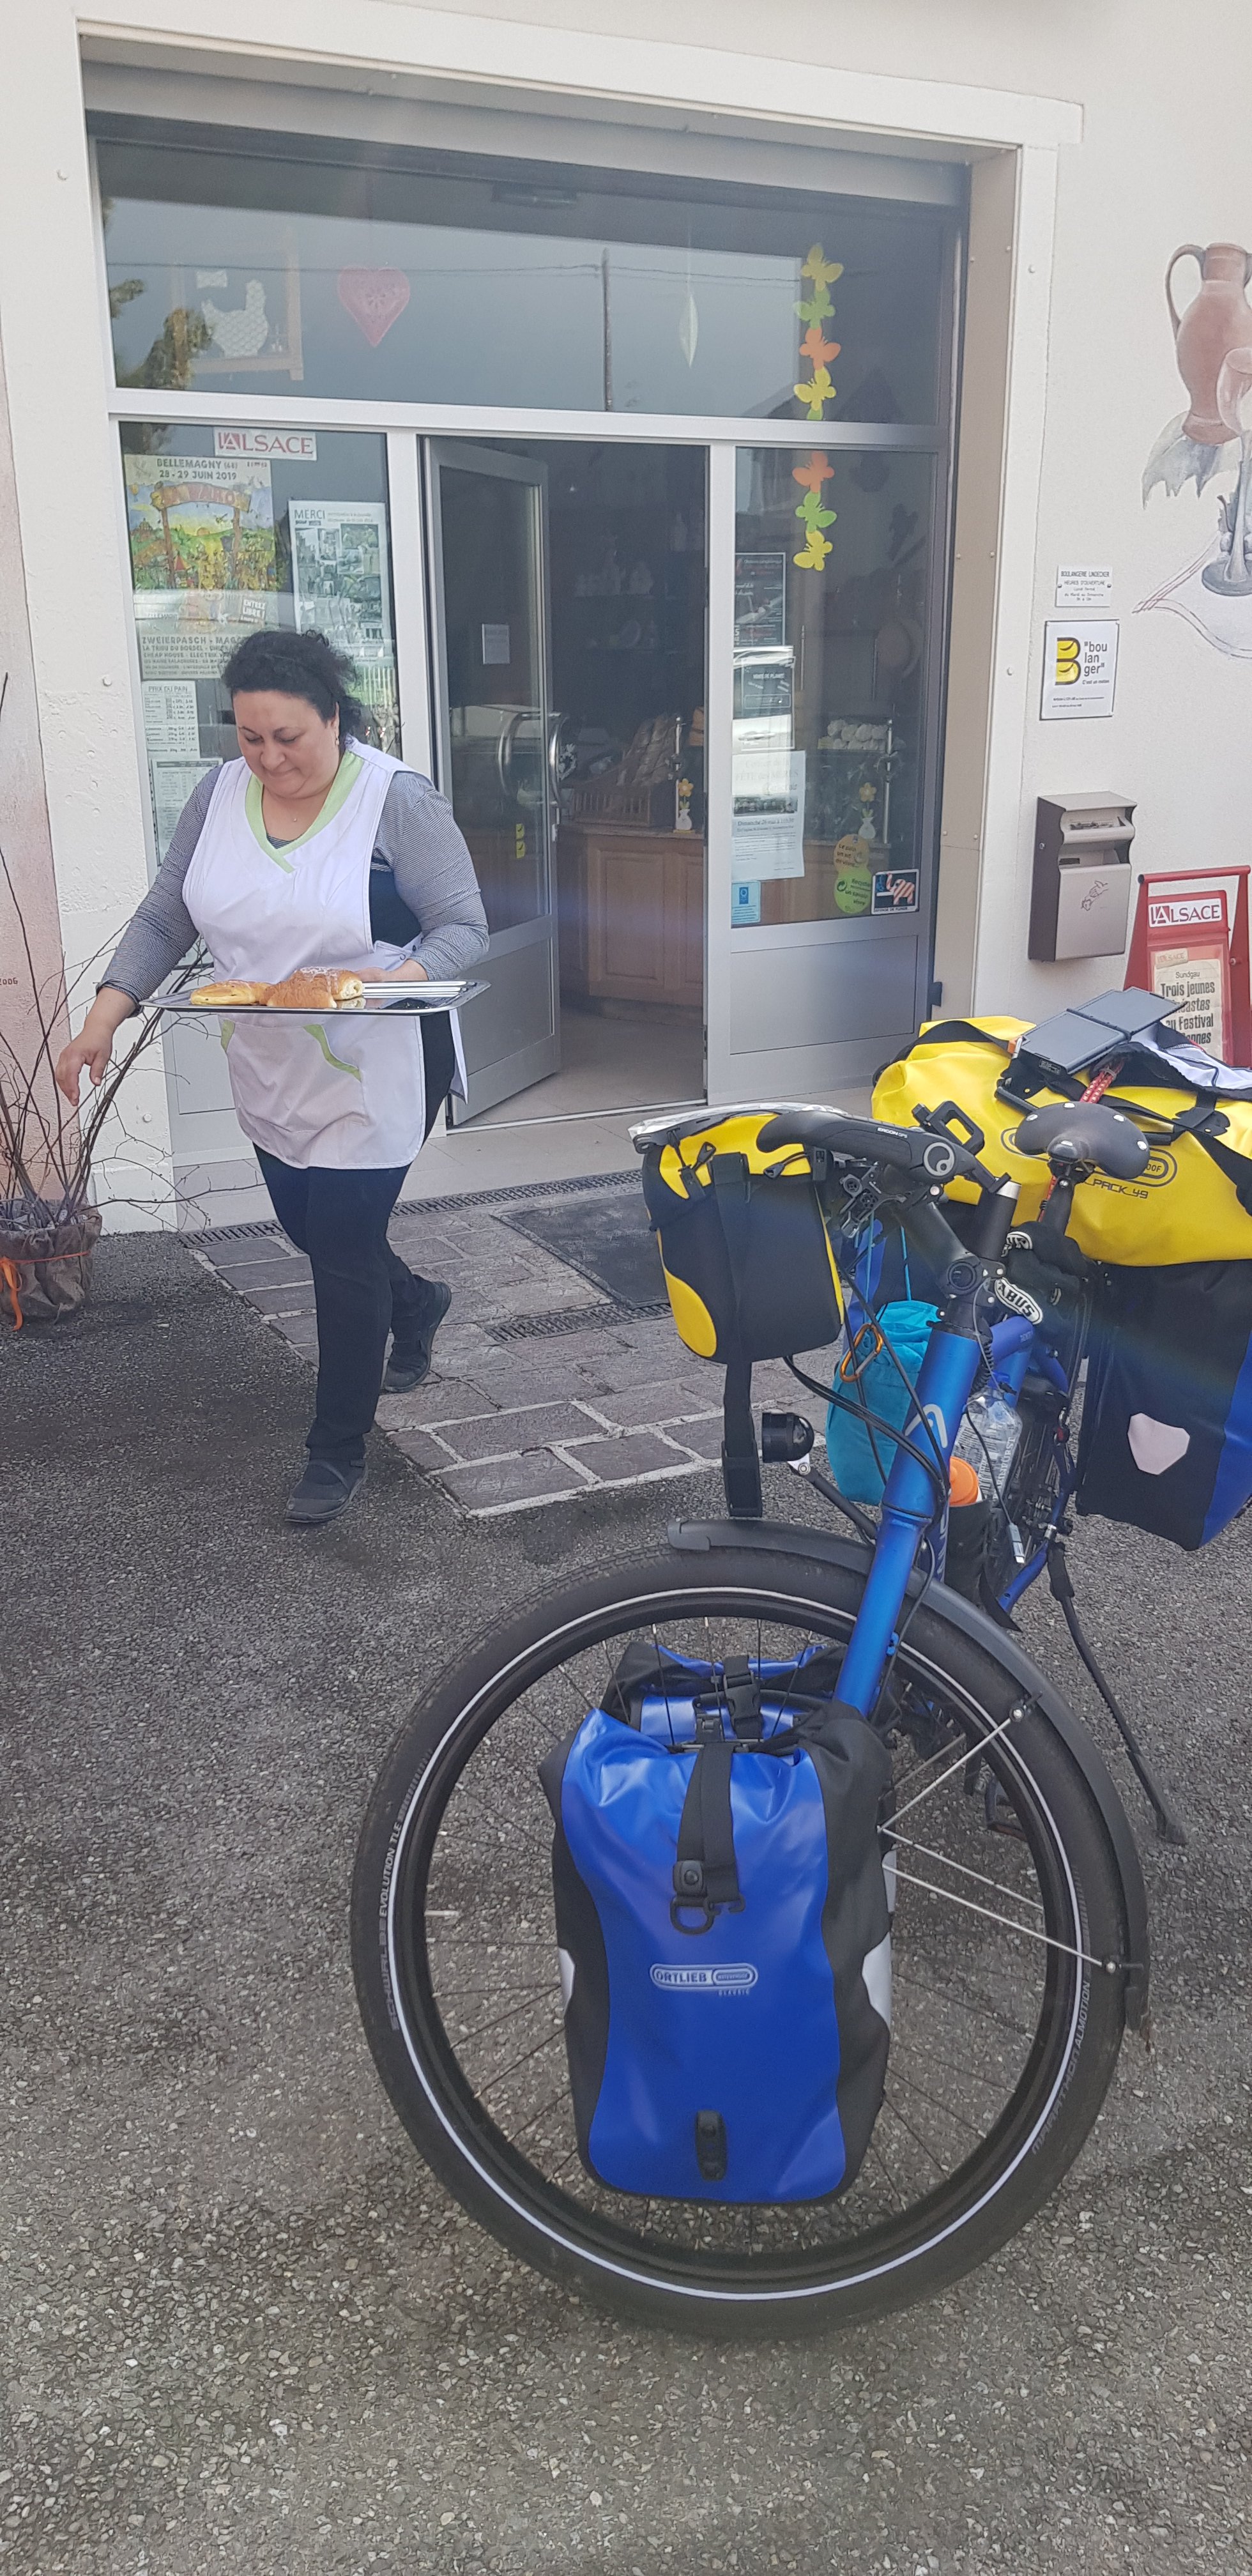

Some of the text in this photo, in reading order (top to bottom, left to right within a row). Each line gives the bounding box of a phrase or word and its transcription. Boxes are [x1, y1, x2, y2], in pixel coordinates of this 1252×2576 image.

[156, 459, 221, 470] BELLEMAGNY
[160, 470, 169, 478] 28
[178, 470, 188, 479] 29
[192, 470, 213, 479] JUIN
[216, 471, 237, 480] 2019
[294, 509, 325, 519] MERCI
[1084, 652, 1099, 663] lan
[1161, 981, 1215, 999] Trois jeunes
[1179, 1013, 1214, 1031] Festival
[877, 1127, 898, 1136] ERGON
[998, 1283, 1035, 1317] ABUS
[379, 1847, 395, 1917] EVOLUTION
[656, 1970, 707, 1984] ORTLIEB
[718, 1989, 750, 1997] CLASSIC
[1031, 1981, 1090, 2155] MARATHON ALMOTION
